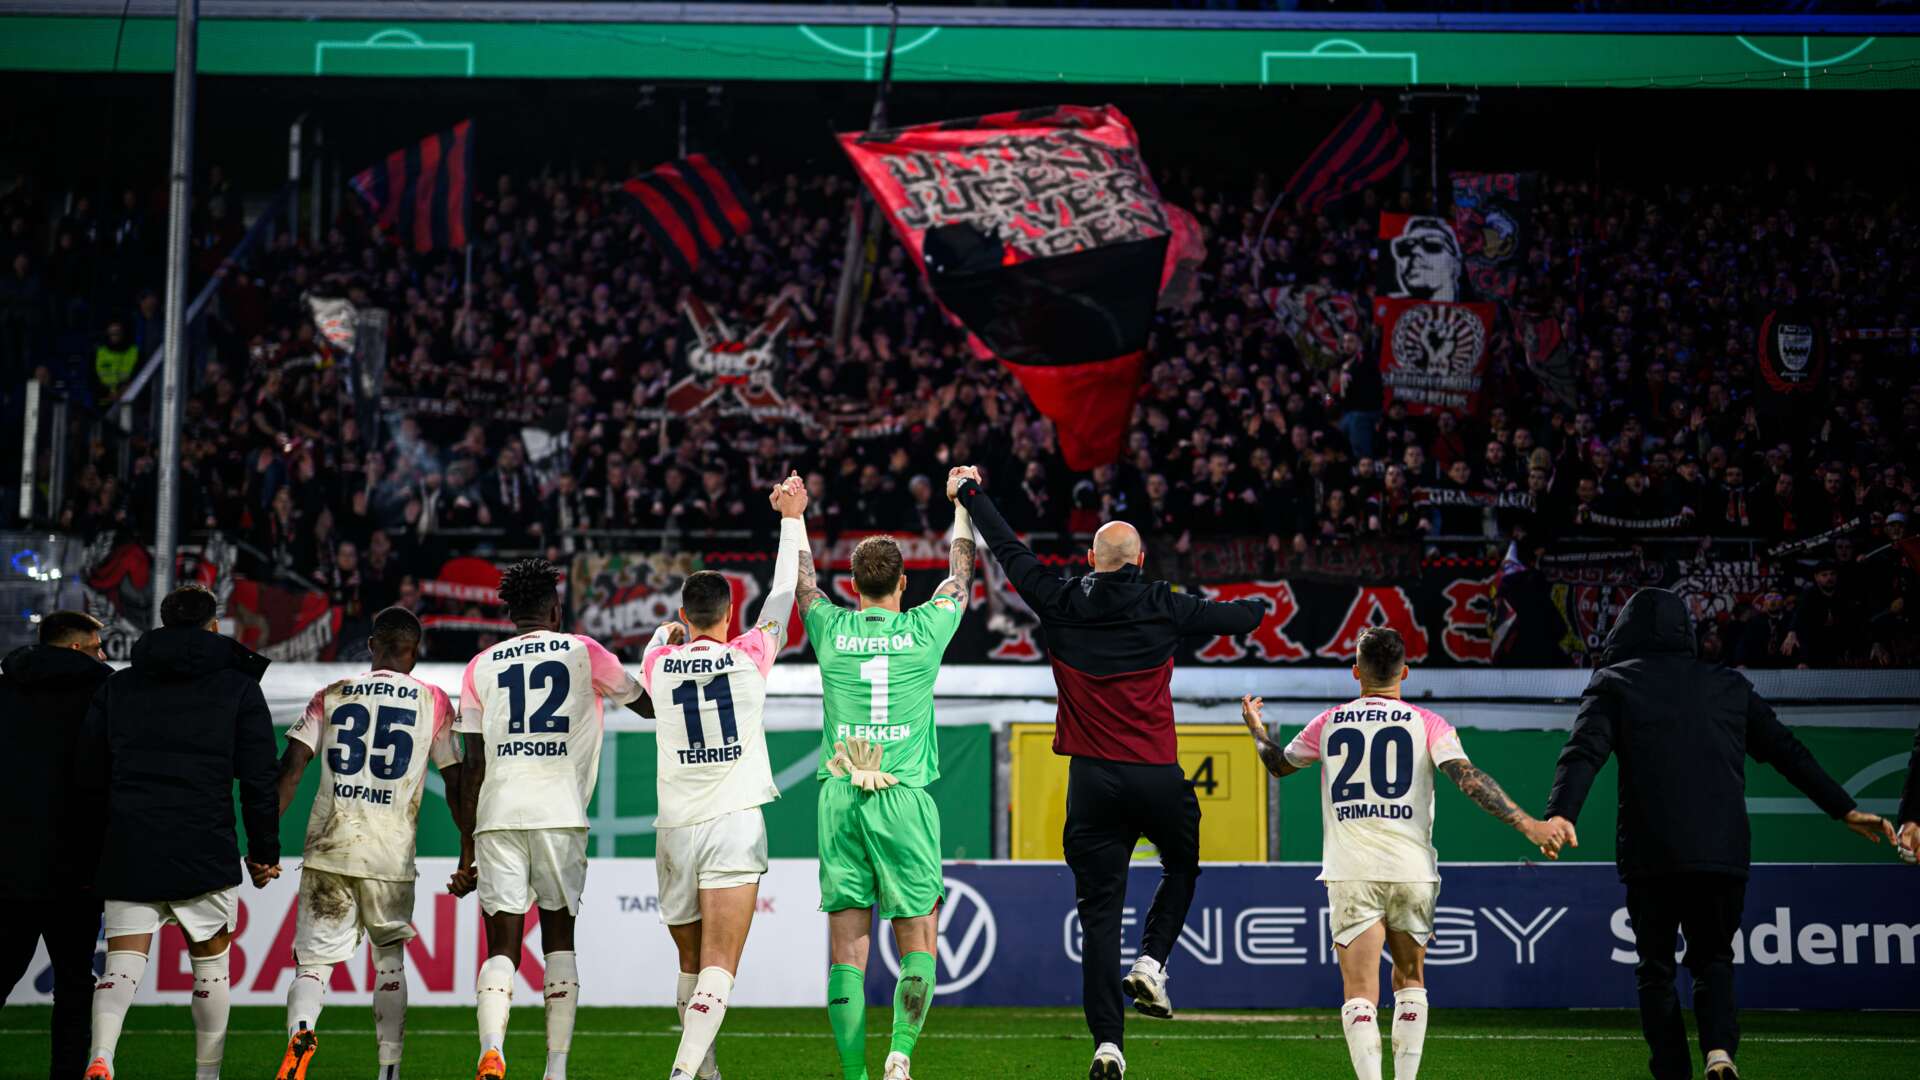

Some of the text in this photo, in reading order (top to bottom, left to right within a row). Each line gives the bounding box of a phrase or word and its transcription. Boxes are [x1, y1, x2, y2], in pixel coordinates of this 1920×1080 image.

[492, 640, 571, 661] BAYER 04
[835, 632, 914, 653] BAYER 04
[663, 652, 734, 674] BAYER 04
[341, 682, 419, 701] BAYER 04
[497, 660, 571, 734] 12
[860, 655, 889, 725] 1
[671, 673, 739, 750] 11
[1333, 710, 1412, 724] BAYER 04
[327, 703, 418, 780] 35
[837, 724, 911, 741] FLEKKEN
[497, 741, 568, 757] TAPSOBA
[677, 744, 743, 765] TERRIER
[1327, 725, 1414, 804] 20
[333, 782, 393, 805] KOFANE
[1609, 906, 1920, 966] Sderm
